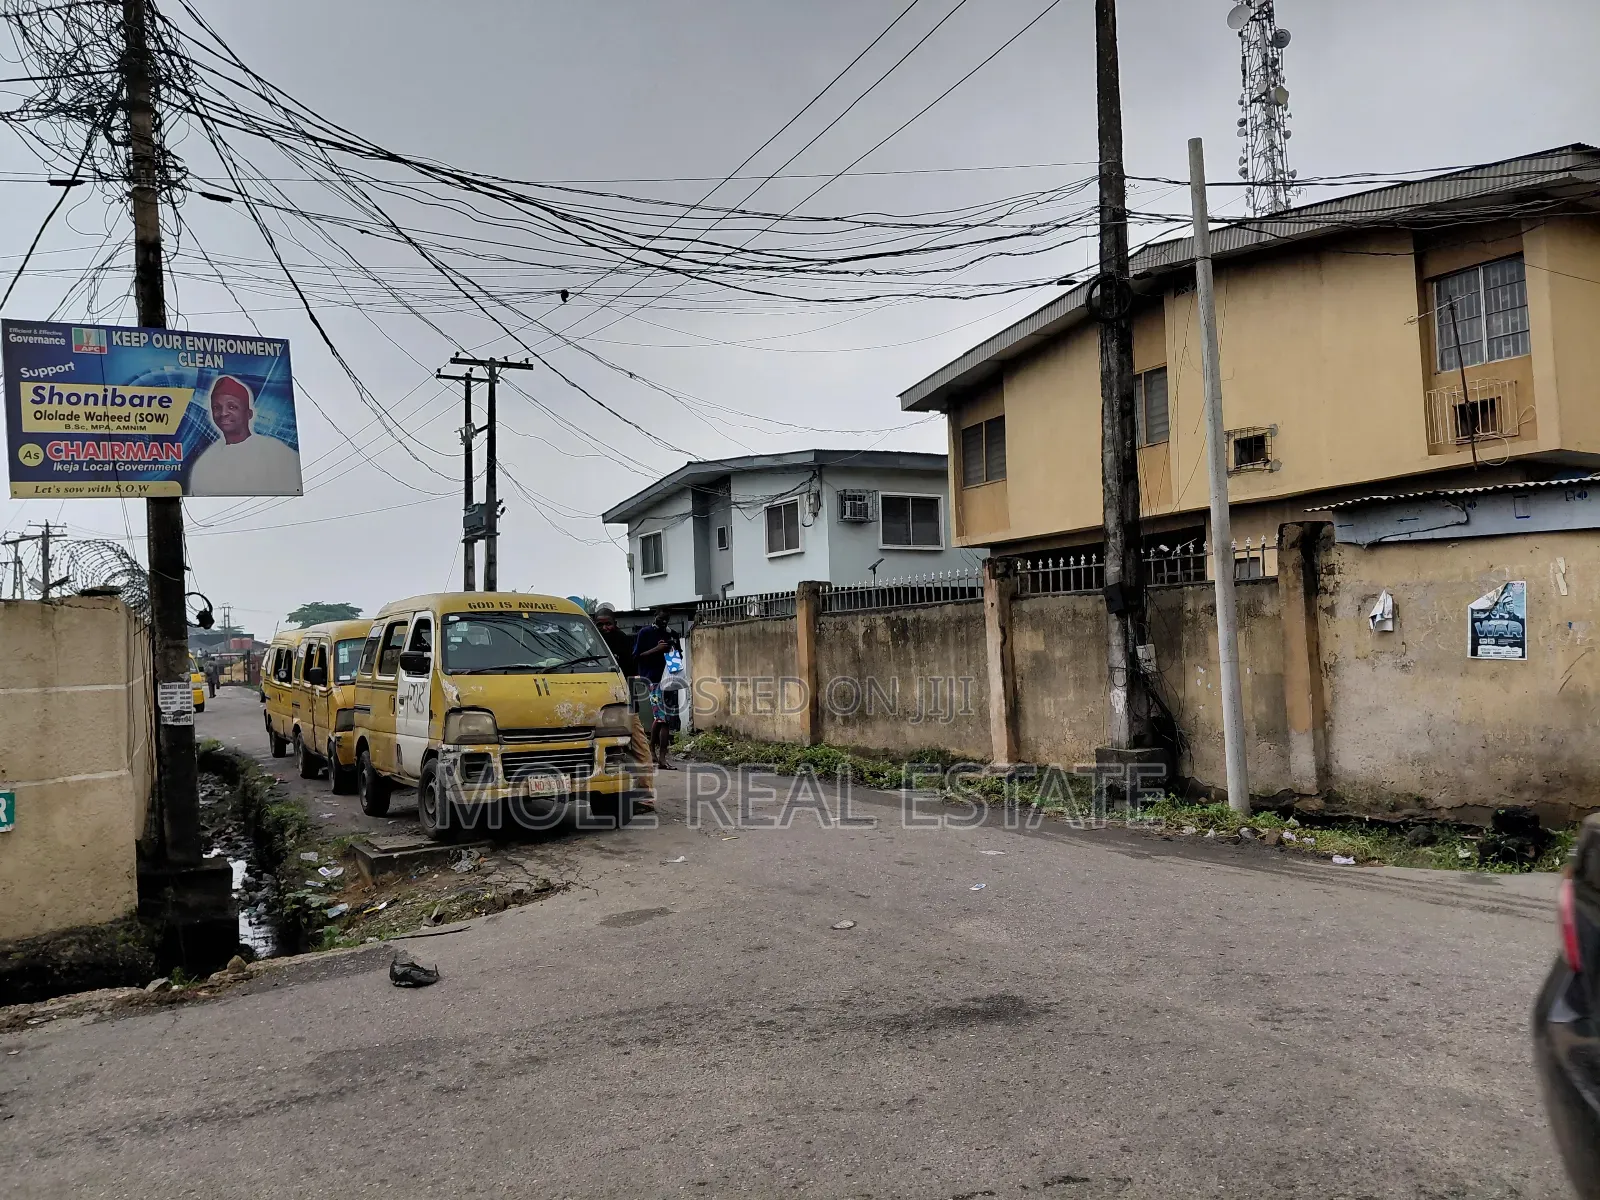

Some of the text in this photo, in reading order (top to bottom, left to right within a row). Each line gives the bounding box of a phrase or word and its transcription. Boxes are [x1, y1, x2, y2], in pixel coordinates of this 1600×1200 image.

[9, 334, 66, 346] Governance
[112, 331, 282, 357] KEEP OUR ENVIRONMENT
[178, 353, 224, 369] CLEAN
[20, 361, 75, 378] Support
[30, 385, 173, 409] Shonibare
[33, 410, 169, 425] Ololade Waheed (SOW)
[23, 450, 40, 460] As
[46, 441, 183, 462] CHAIRMAN
[53, 462, 182, 473] Ikeja Local Government
[34, 485, 61, 494] Let's
[64, 486, 85, 494] sow
[87, 484, 112, 493] with
[467, 601, 559, 611] GOD IS AWARE
[1474, 620, 1523, 638] WAR
